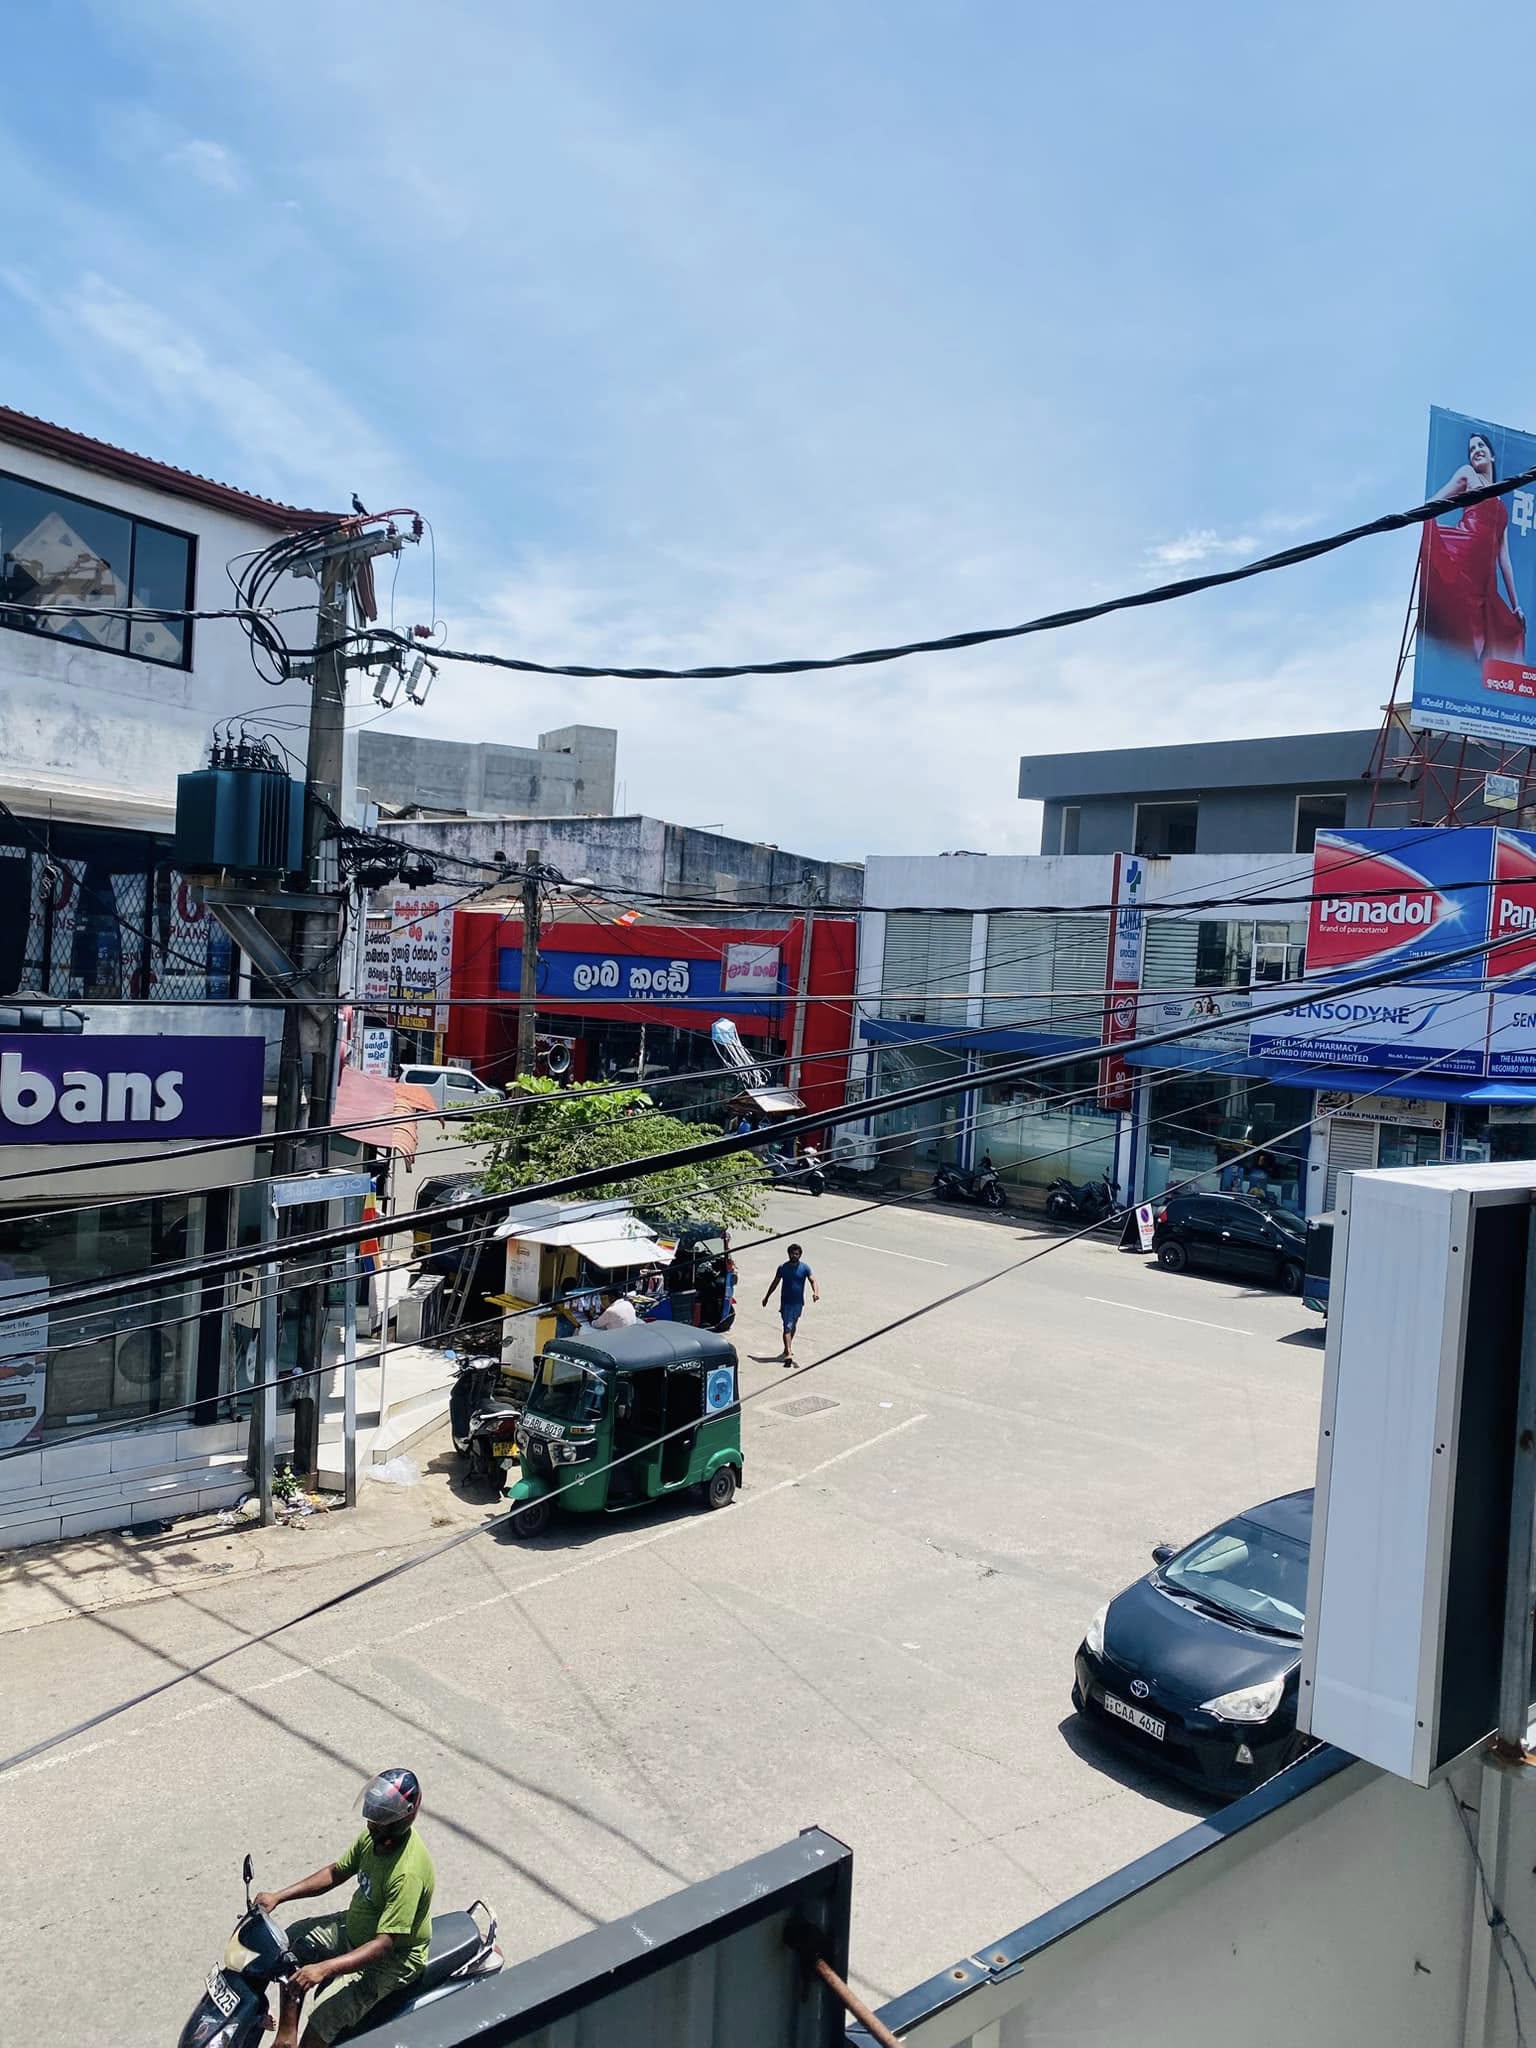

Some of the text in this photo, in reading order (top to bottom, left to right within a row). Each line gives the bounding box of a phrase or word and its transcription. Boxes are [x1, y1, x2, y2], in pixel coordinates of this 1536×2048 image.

[1321, 896, 1433, 924] Panadol
[1500, 899, 1536, 928] Pan
[168, 925, 209, 940] PLANS
[573, 960, 690, 993] ලාබ කඩේ
[1283, 1003, 1410, 1024] SENSODYNE
[1272, 1039, 1287, 1047] THE
[1314, 1042, 1358, 1052] PHARMACY
[1300, 1049, 1336, 1061] (PRIVATE)
[1337, 1053, 1369, 1063] LIMITED
[1491, 1064, 1519, 1073] NEGOMBO
[1, 1052, 184, 1125] bans
[1361, 1112, 1397, 1122] PHARMACY
[530, 1418, 543, 1430] ABL
[1115, 1702, 1163, 1738] CAA 4610
